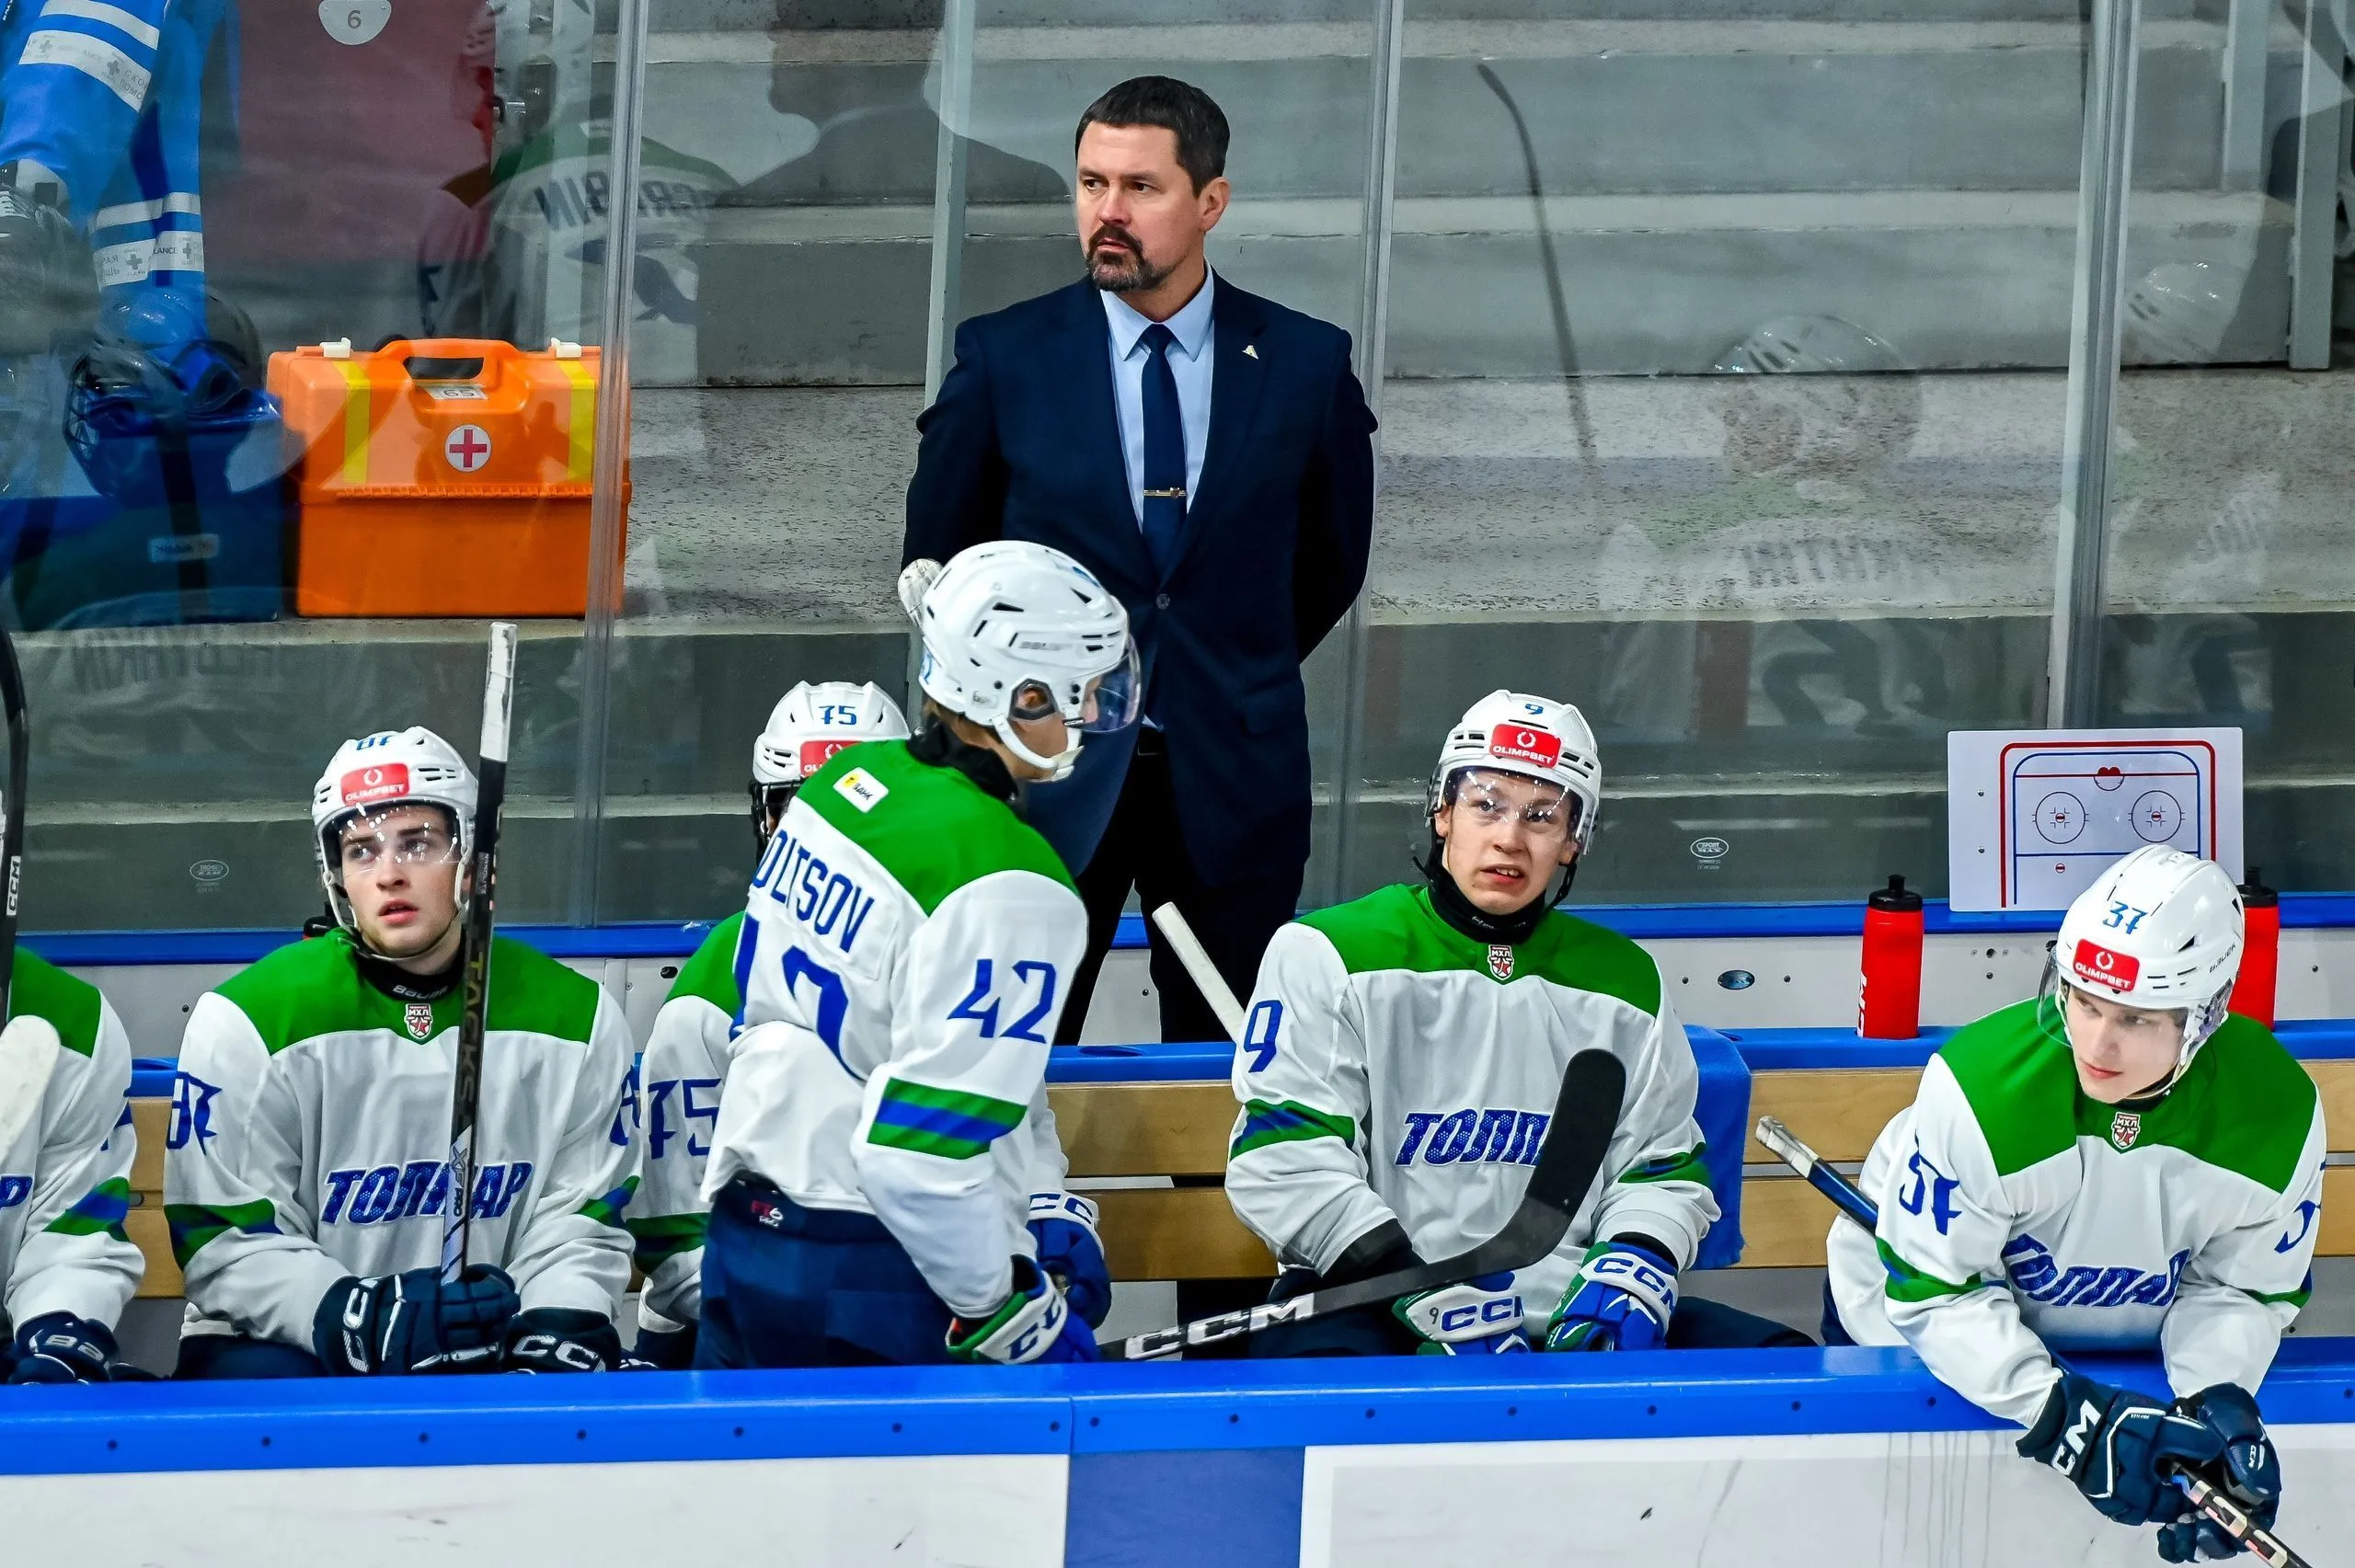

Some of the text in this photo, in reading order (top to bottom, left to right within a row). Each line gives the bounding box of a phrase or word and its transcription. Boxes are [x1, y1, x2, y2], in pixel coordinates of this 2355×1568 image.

[347, 9, 362, 29] 6
[819, 704, 857, 726] 75
[1524, 704, 1545, 715] 9
[1492, 745, 1555, 765] OLIMPBET
[345, 784, 405, 802] OLIMPBET
[8, 860, 20, 911] CCM
[2103, 899, 2149, 935] 37
[2074, 962, 2131, 990] OLIMPBET
[946, 958, 1057, 1045] 42
[1244, 1000, 1284, 1074] 9
[647, 1078, 722, 1160] 75
[2117, 1117, 2138, 1127] МХЛ
[1394, 1107, 1555, 1168] ТОЛП
[1124, 1292, 1315, 1359] CCM
